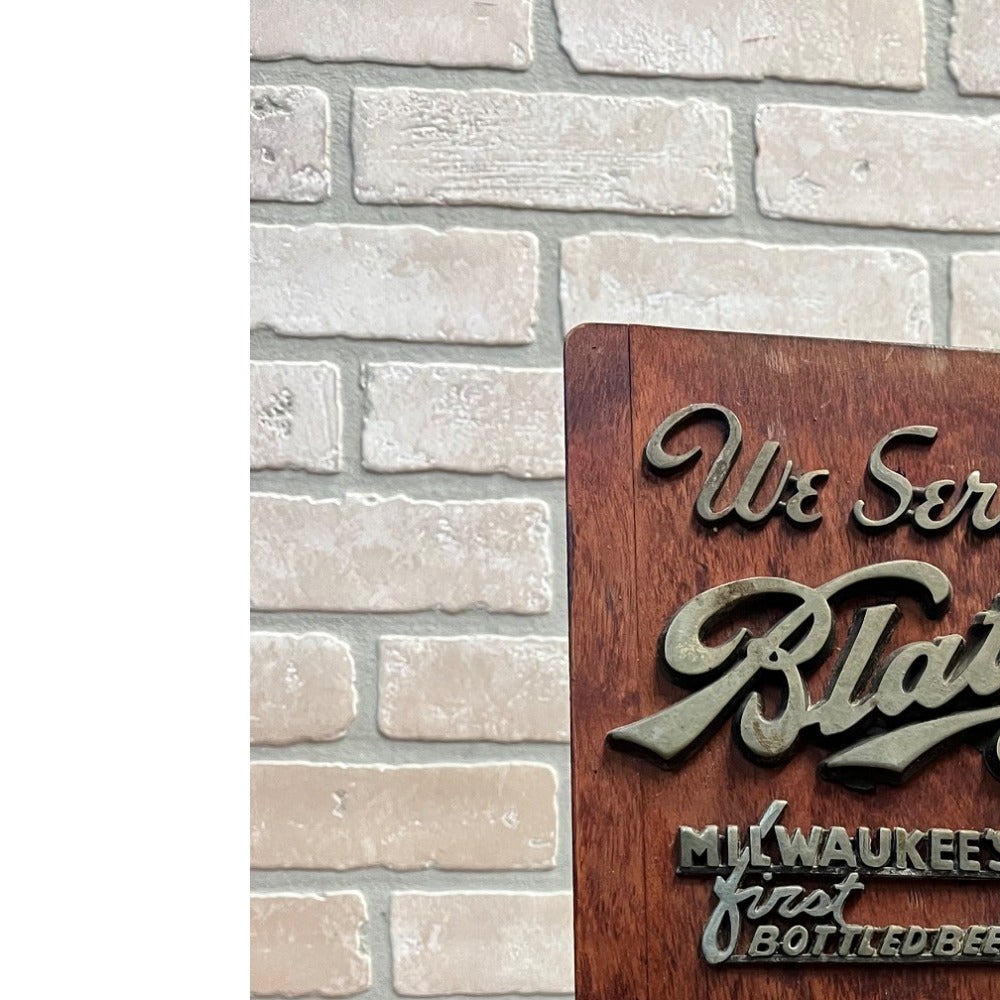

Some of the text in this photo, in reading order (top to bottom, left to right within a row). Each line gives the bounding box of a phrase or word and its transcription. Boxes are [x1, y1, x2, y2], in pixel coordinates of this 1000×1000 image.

[643, 402, 829, 525] We
[702, 799, 865, 963] first
[748, 924, 928, 957] BOTTLED
